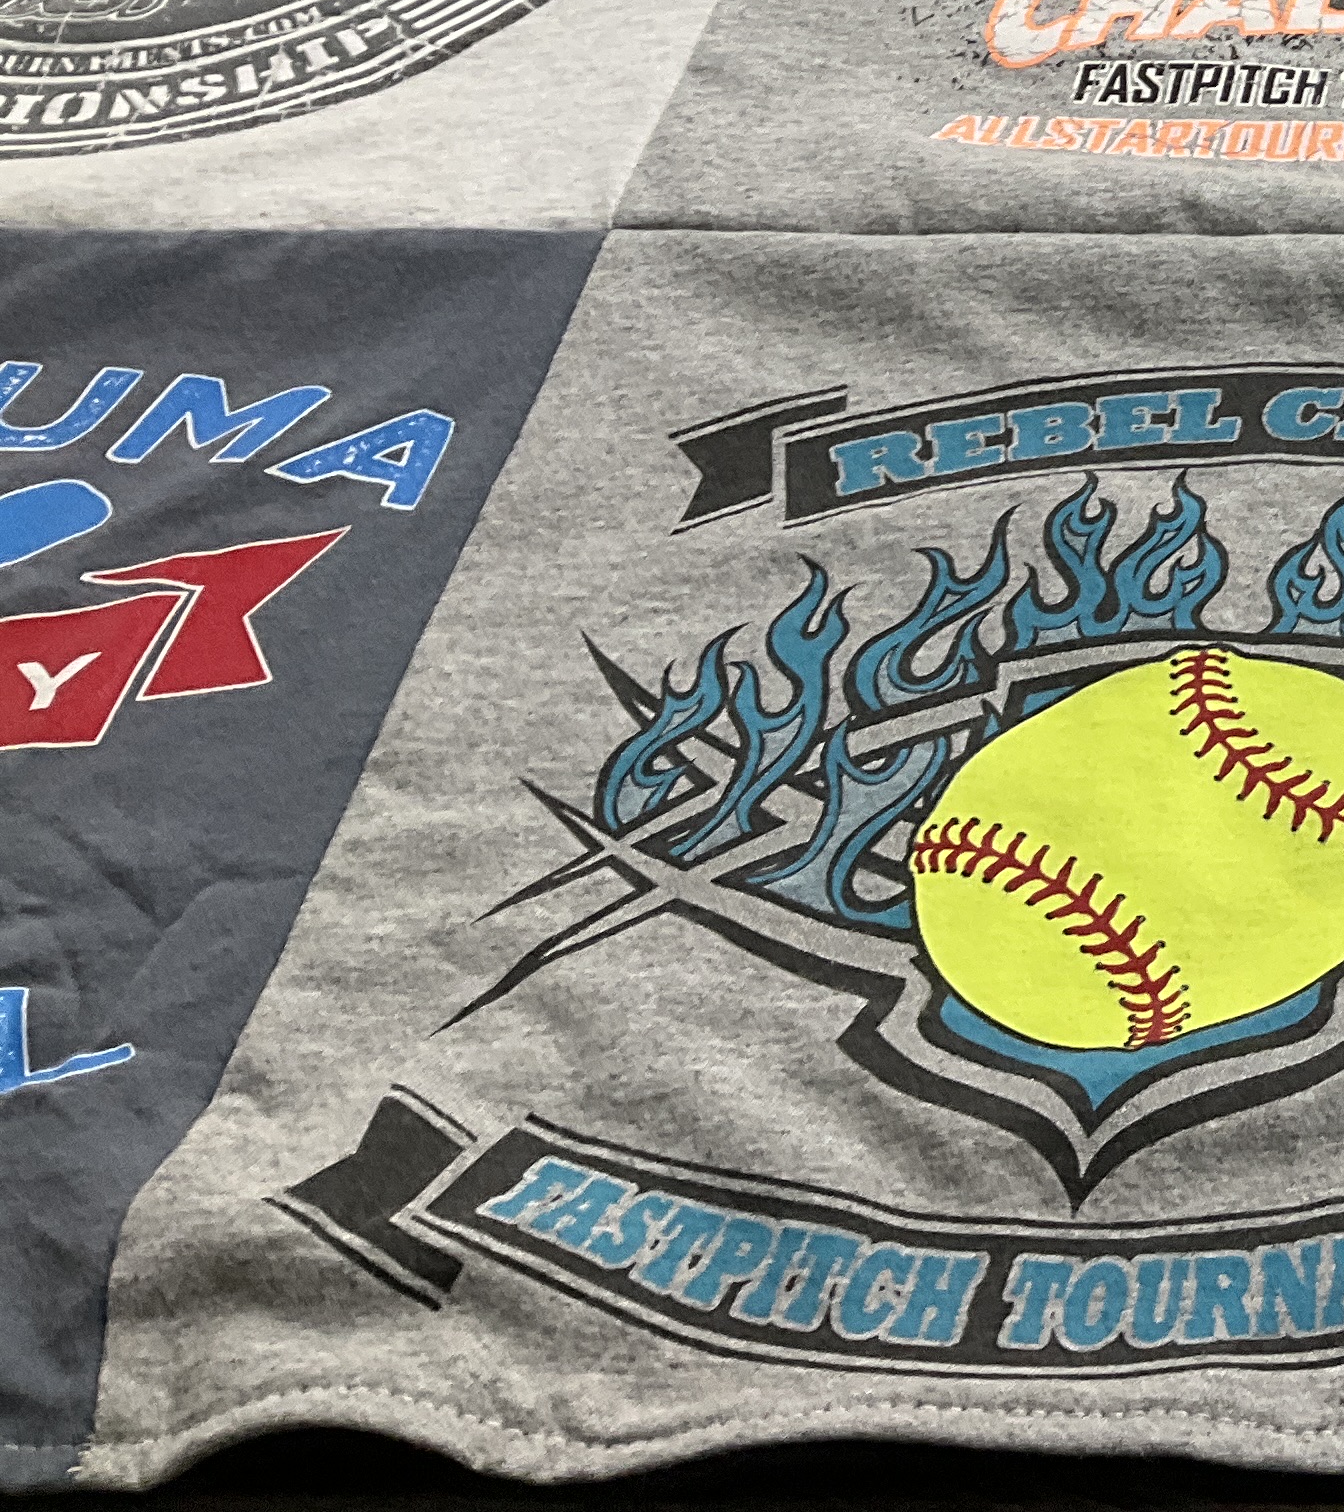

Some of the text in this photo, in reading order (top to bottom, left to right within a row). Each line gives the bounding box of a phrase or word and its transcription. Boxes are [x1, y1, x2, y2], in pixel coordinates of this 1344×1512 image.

[1073, 59, 1328, 111] FASTPITCH
[831, 386, 1242, 499] REBEL
[475, 1153, 995, 1350] FASTPITCH
